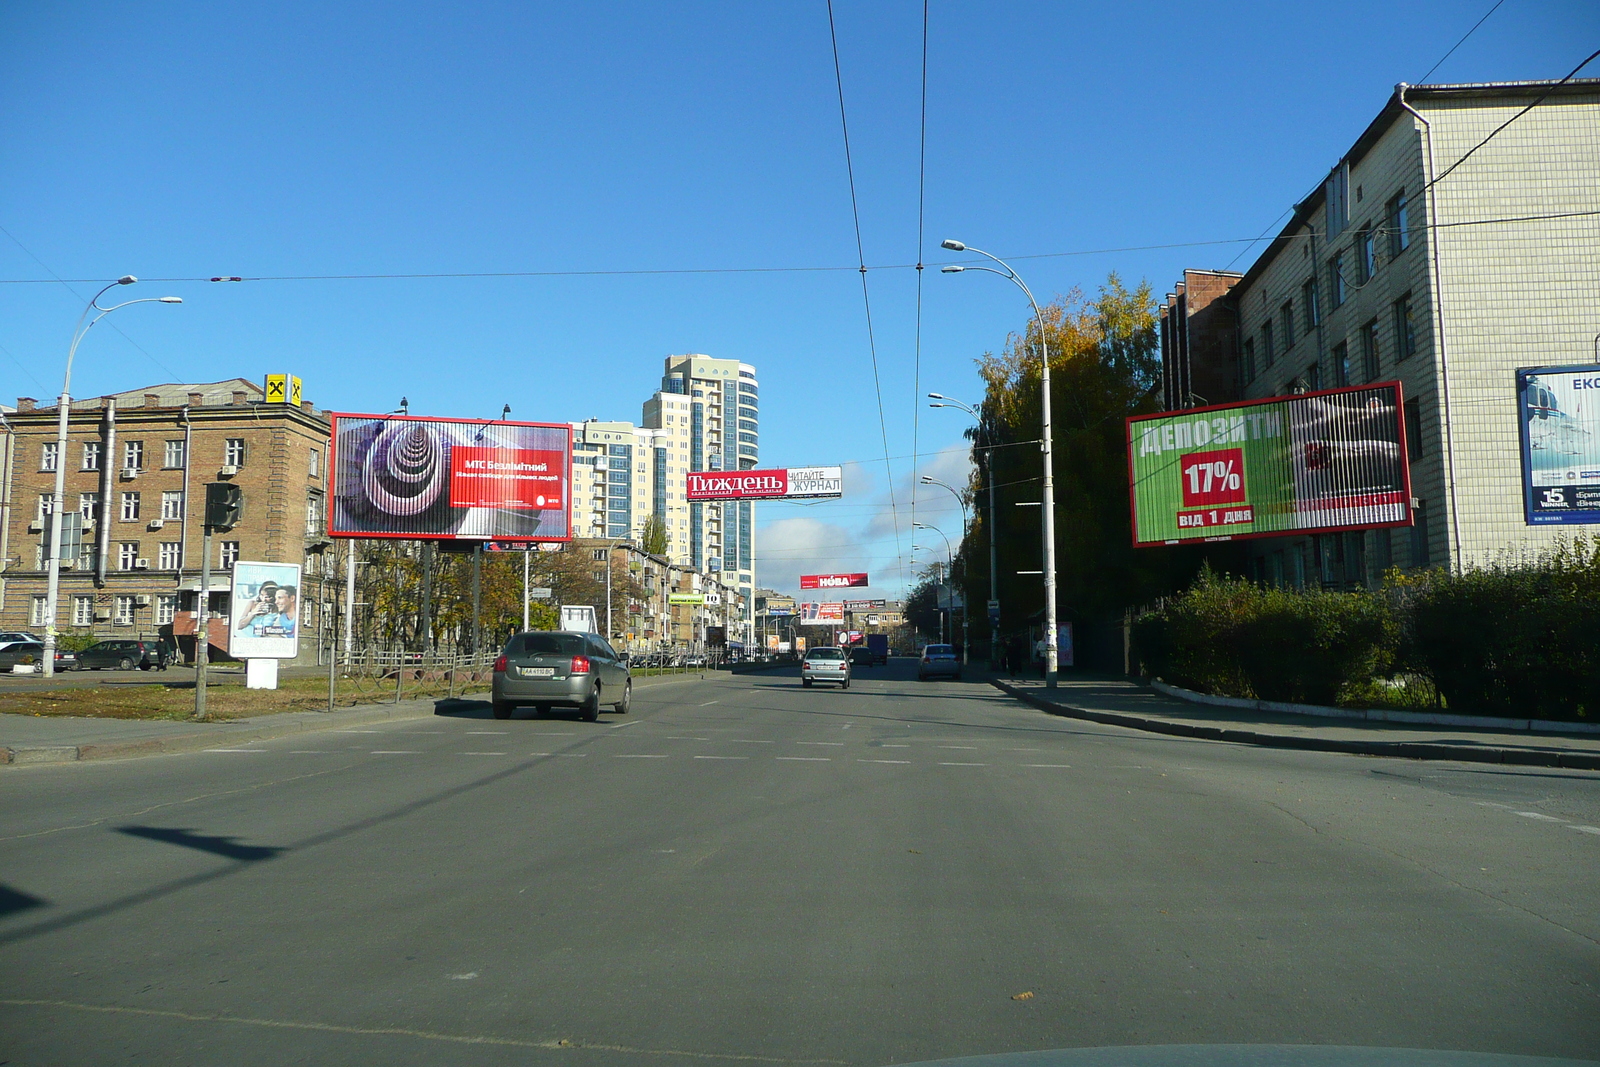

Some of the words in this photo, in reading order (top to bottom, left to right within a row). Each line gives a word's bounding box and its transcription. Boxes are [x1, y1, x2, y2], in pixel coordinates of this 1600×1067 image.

[1140, 411, 1281, 457] ДЕПОЗИТИ
[465, 460, 486, 470] МТС
[487, 461, 547, 472] Безлімітний
[788, 470, 825, 481] ЧИТАЙТЕ
[1185, 460, 1240, 494] 17%
[688, 475, 783, 495] Тиждень
[793, 480, 840, 492] ЖУРНАЛ
[1543, 488, 1564, 503] 15
[1179, 514, 1204, 527] ВІД
[1209, 510, 1218, 524] 1
[1223, 509, 1252, 524] ДНЯ
[706, 595, 718, 603] IQ
